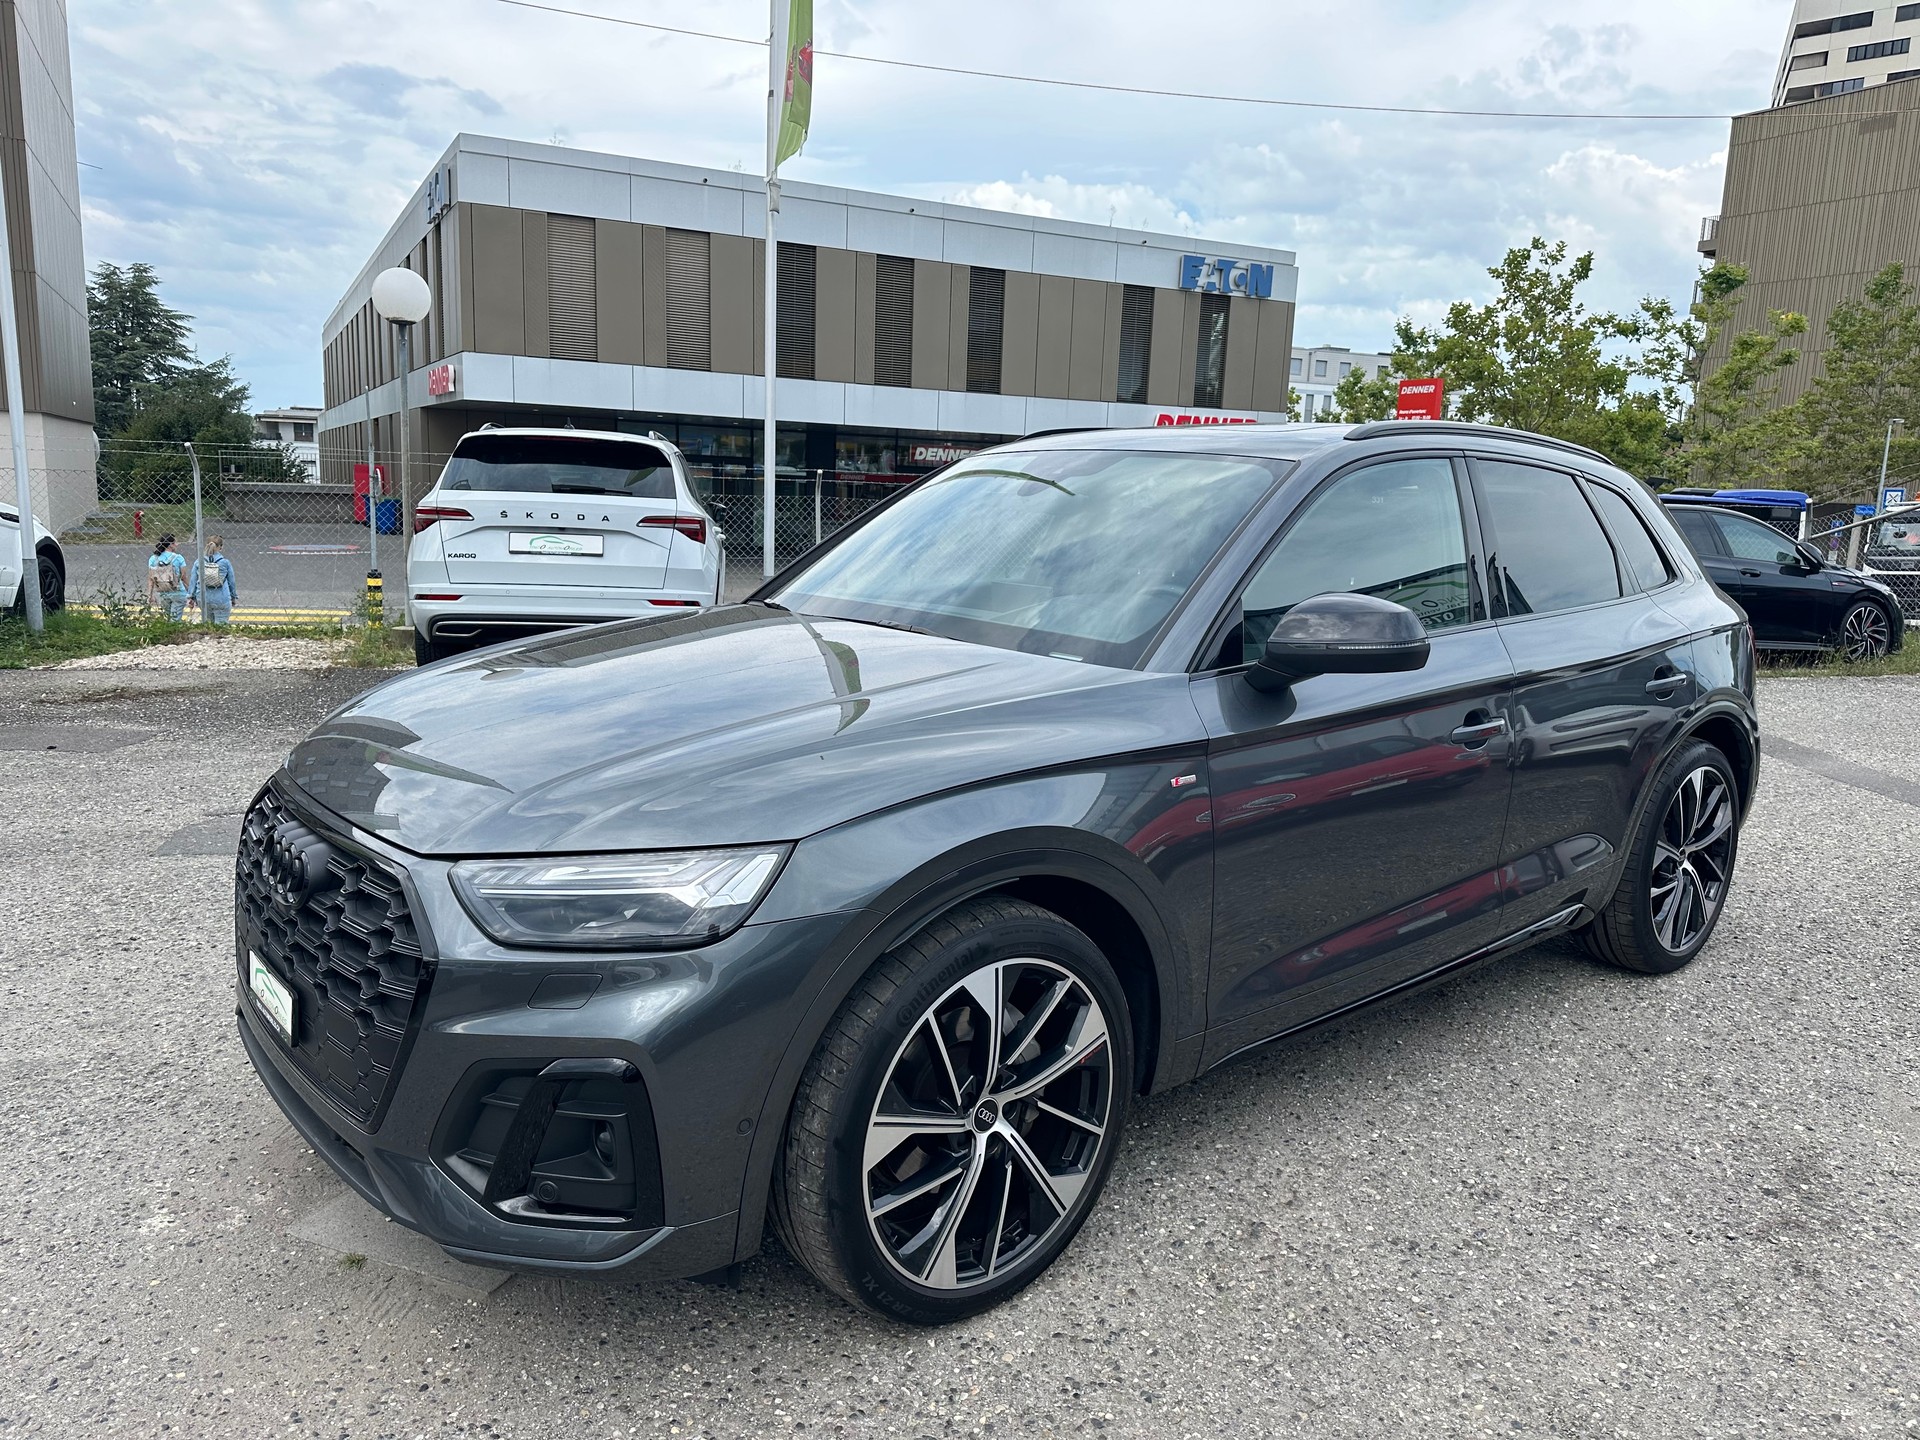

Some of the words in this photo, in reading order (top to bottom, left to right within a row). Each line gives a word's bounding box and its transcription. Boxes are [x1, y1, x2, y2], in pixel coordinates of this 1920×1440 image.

[1180, 254, 1274, 298] EATON
[1401, 385, 1435, 394] DENNER
[500, 510, 610, 522] ŠKODA
[896, 947, 976, 1027] Continental
